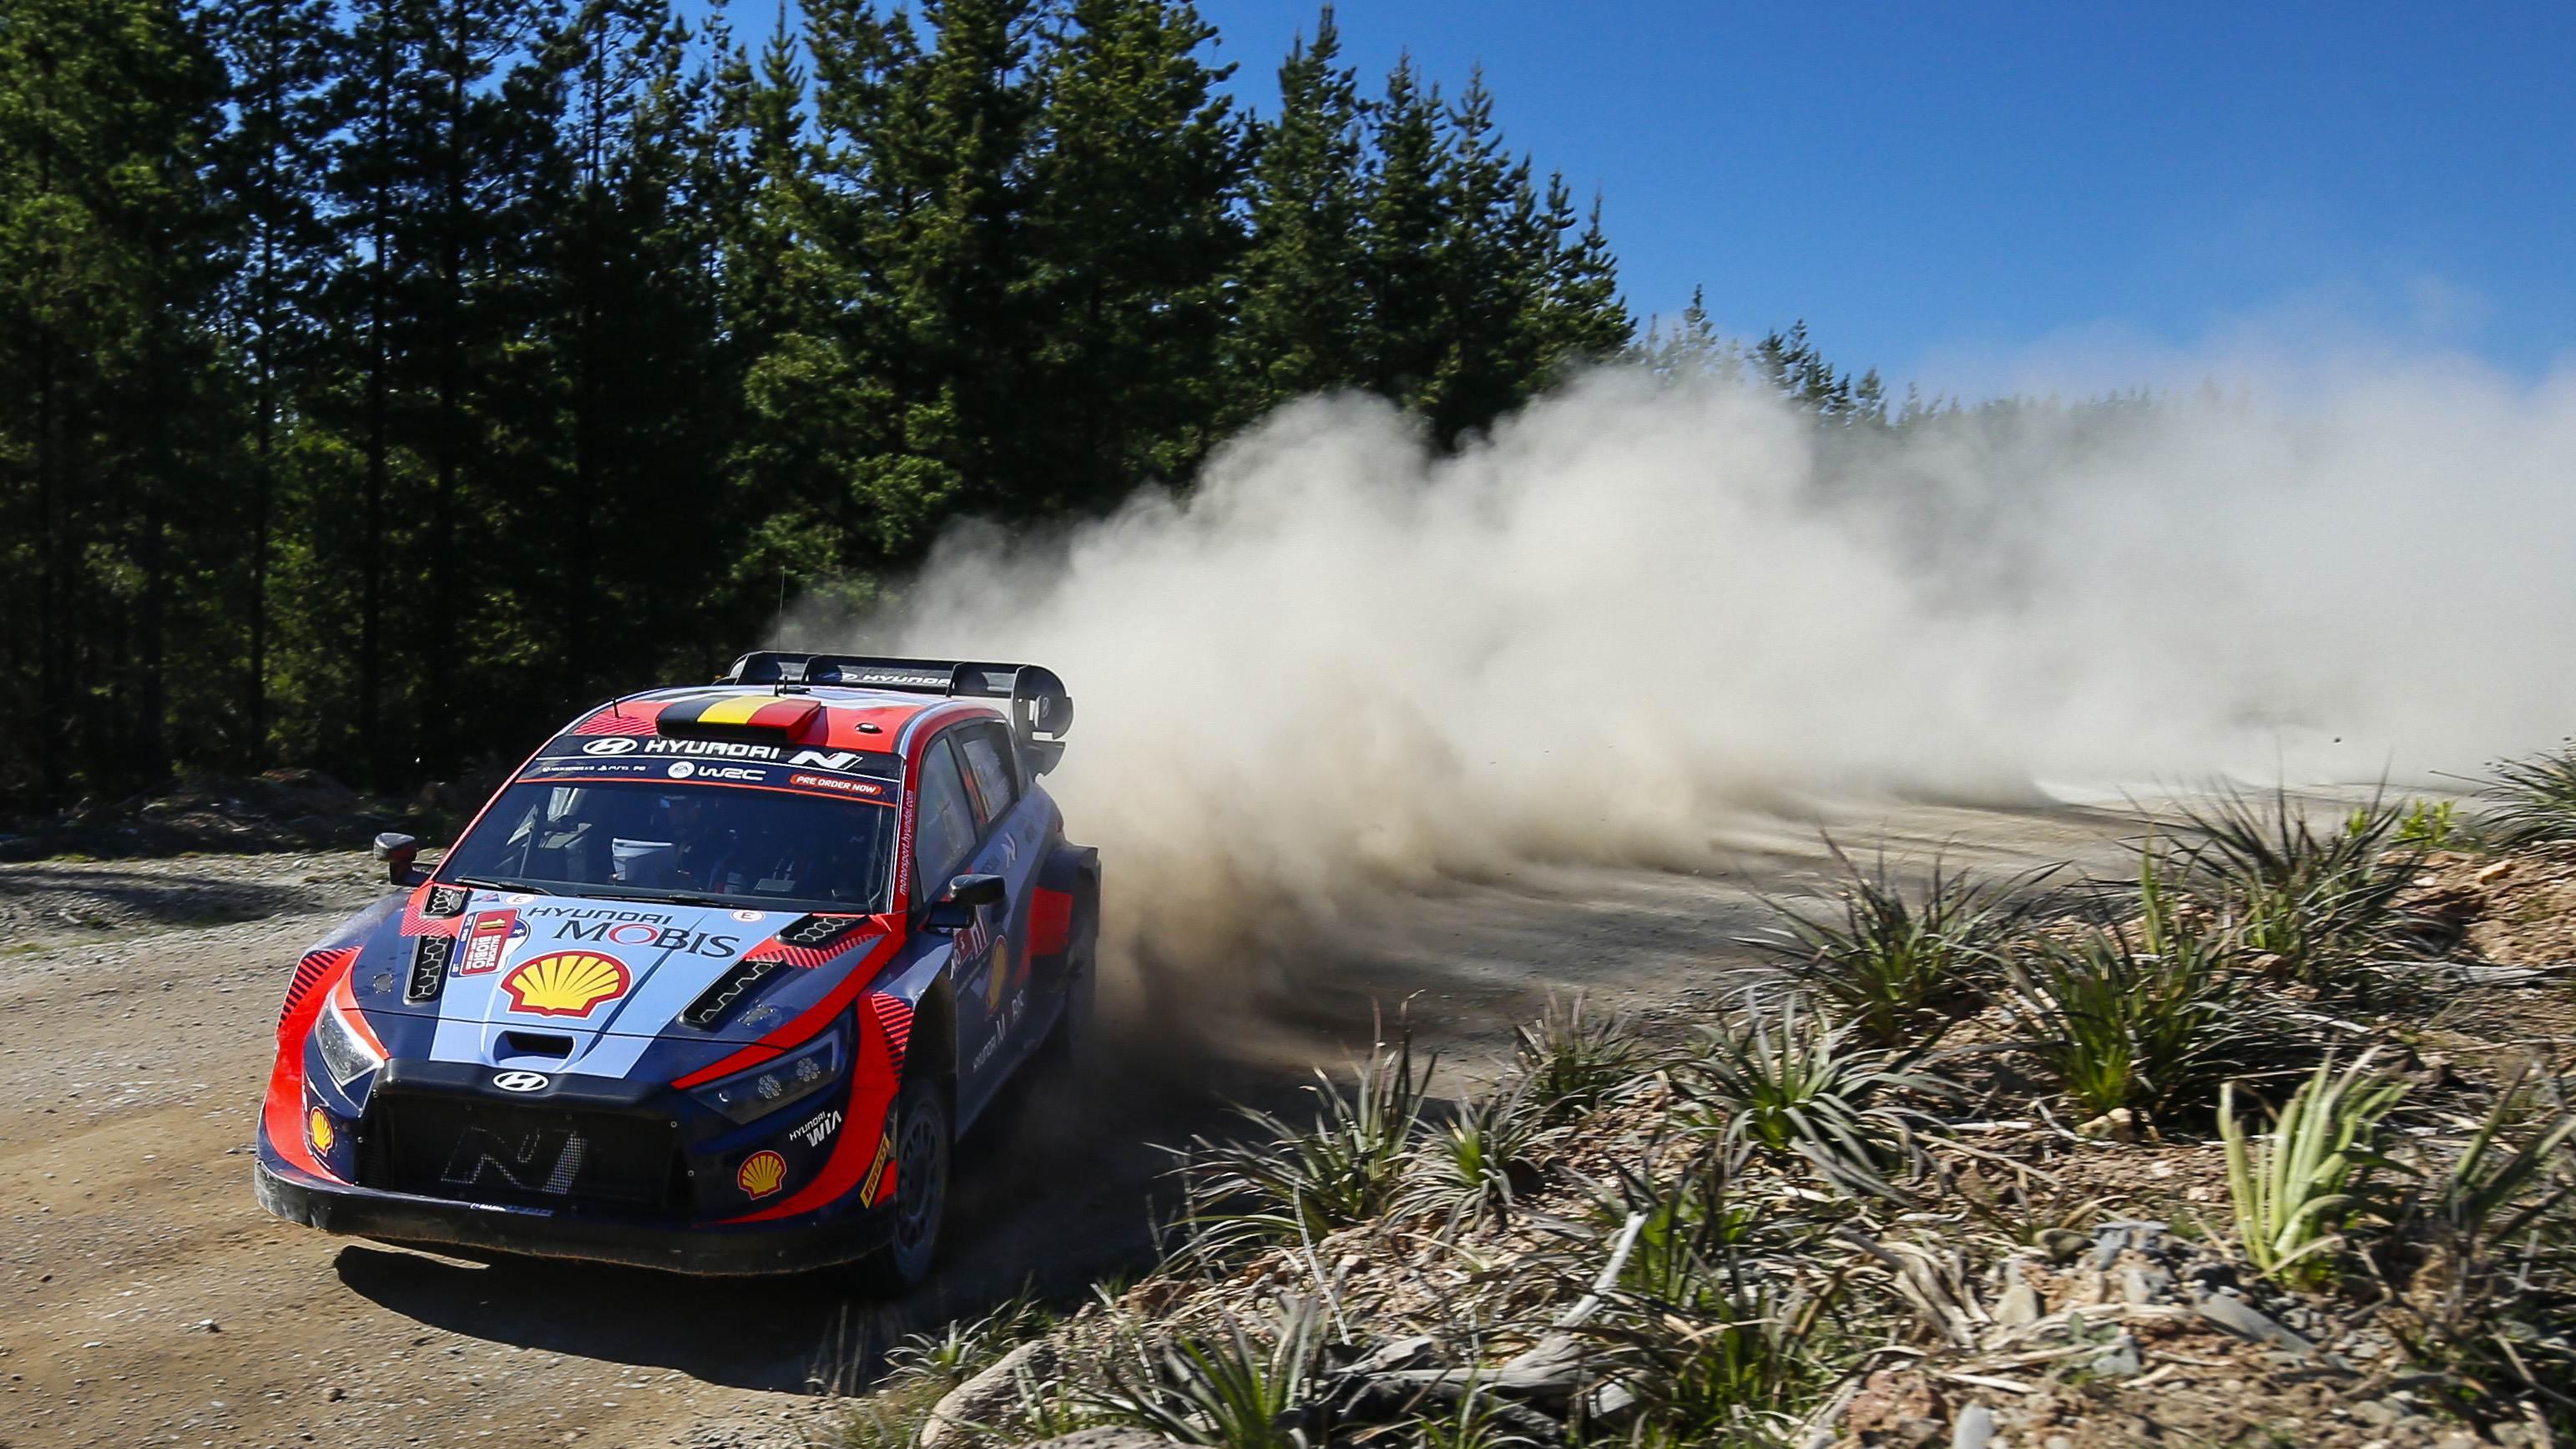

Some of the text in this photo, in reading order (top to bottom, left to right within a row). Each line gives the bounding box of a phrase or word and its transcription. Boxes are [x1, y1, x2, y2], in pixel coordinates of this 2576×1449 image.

[862, 674, 951, 684] HYUNDA
[644, 740, 864, 770] HYUNDAI N
[698, 765, 766, 781] WRC
[796, 775, 876, 793] PRE ORDER NOW
[899, 790, 914, 896] motorsport.hyundai.com
[527, 906, 674, 925] HYUNDAI
[552, 919, 740, 958] MOBIS
[789, 1111, 826, 1141] HYUNDAI
